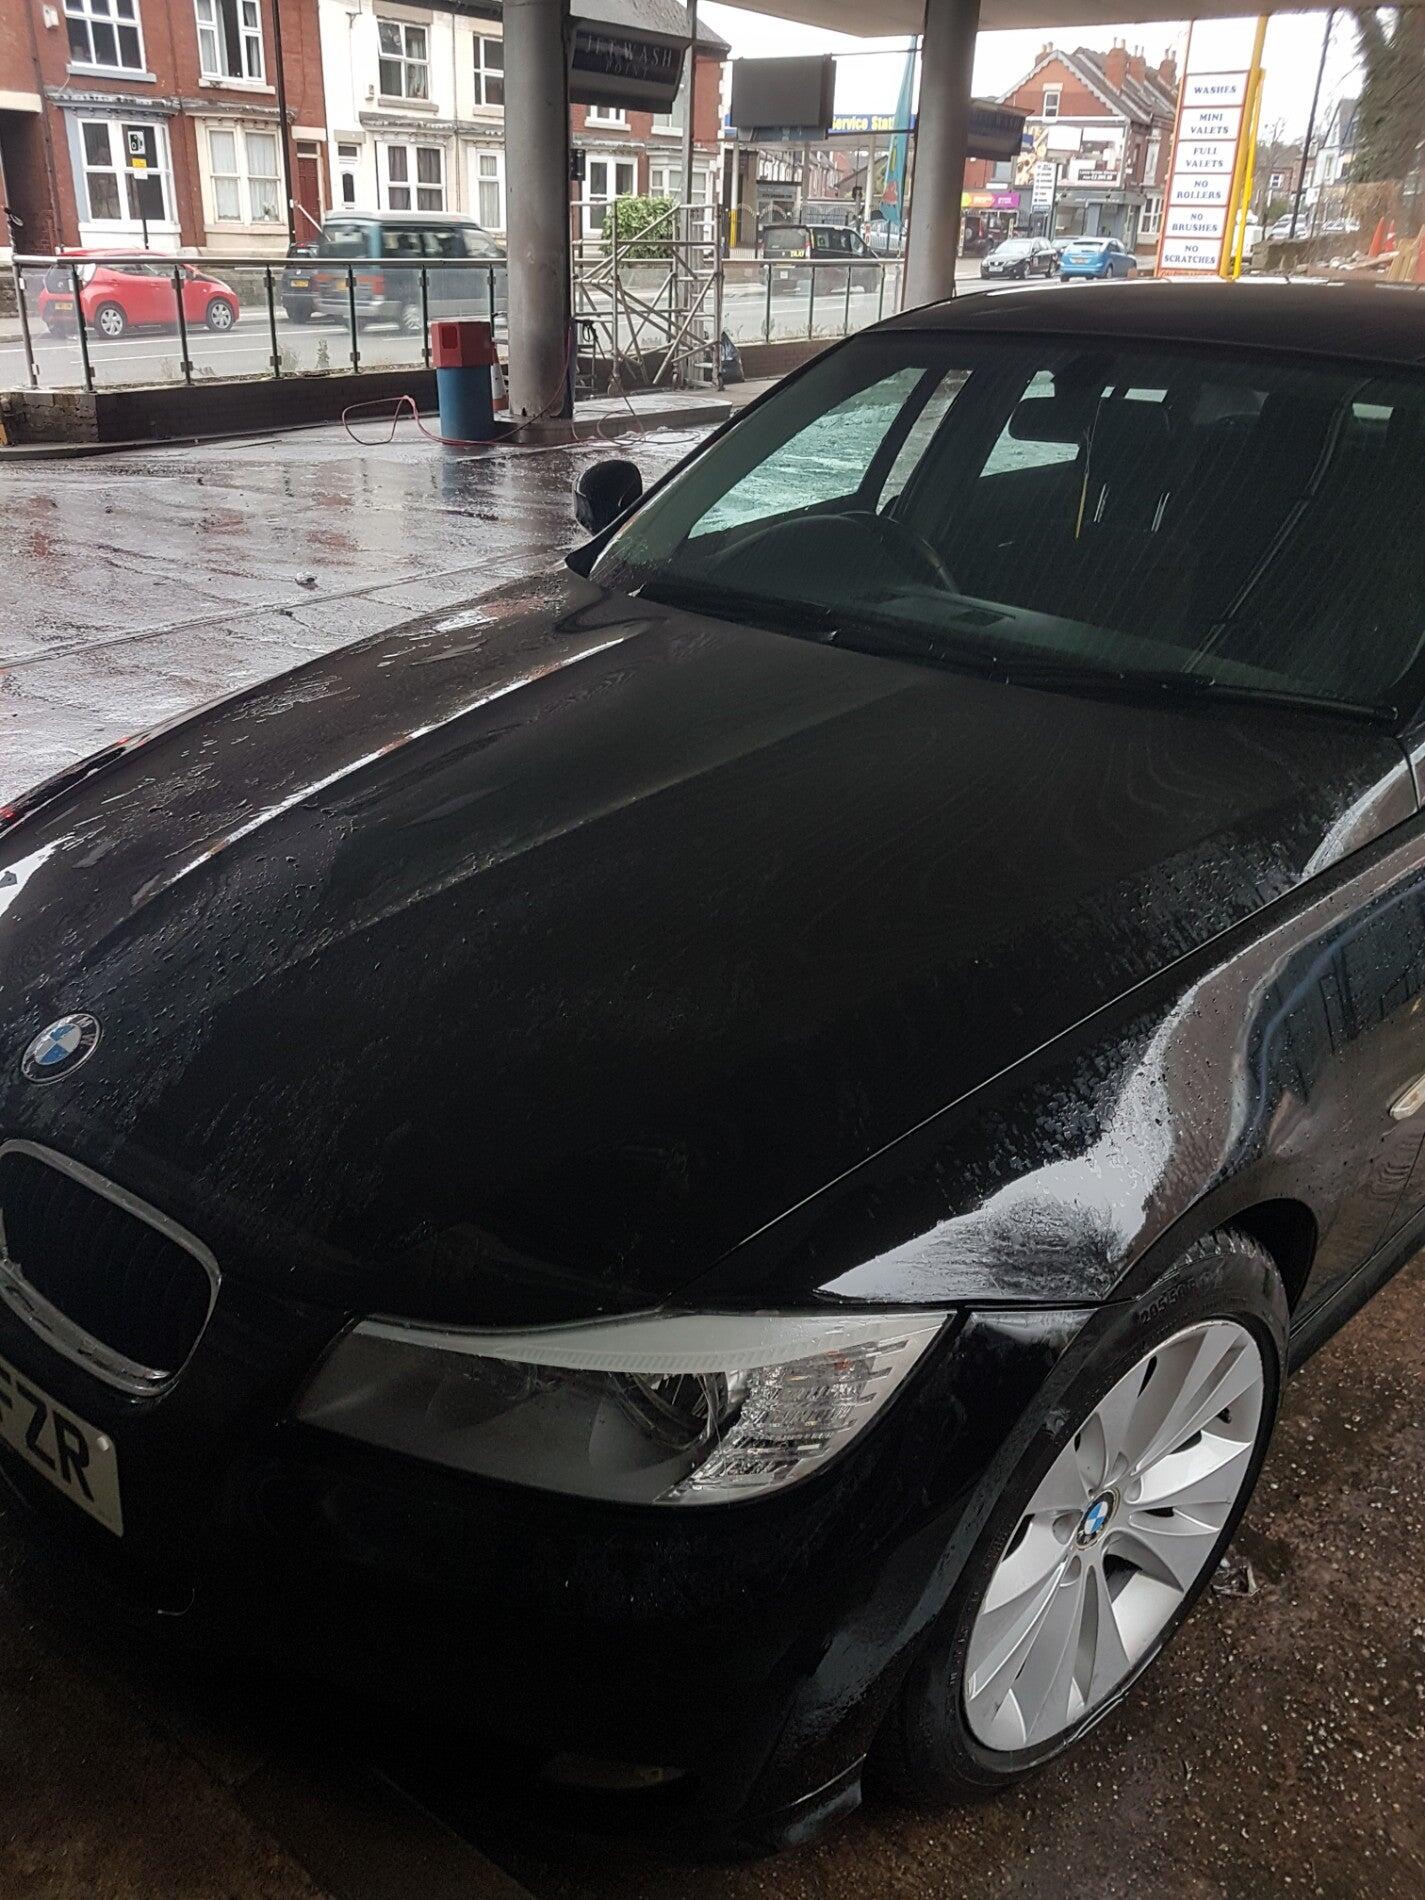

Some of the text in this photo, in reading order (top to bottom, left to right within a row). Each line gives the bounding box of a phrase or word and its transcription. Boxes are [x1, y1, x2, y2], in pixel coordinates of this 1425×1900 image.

[1194, 85, 1236, 94] WASHES
[1199, 113, 1223, 121] MINI
[1190, 126, 1229, 134] VALETS
[1193, 147, 1217, 155] FULL
[1186, 160, 1223, 168] VALETS
[1176, 191, 1221, 199] ROLLERS
[1172, 223, 1218, 232] BRUSHES
[1184, 245, 1199, 253] NO
[1164, 255, 1216, 264] SCRATCHES
